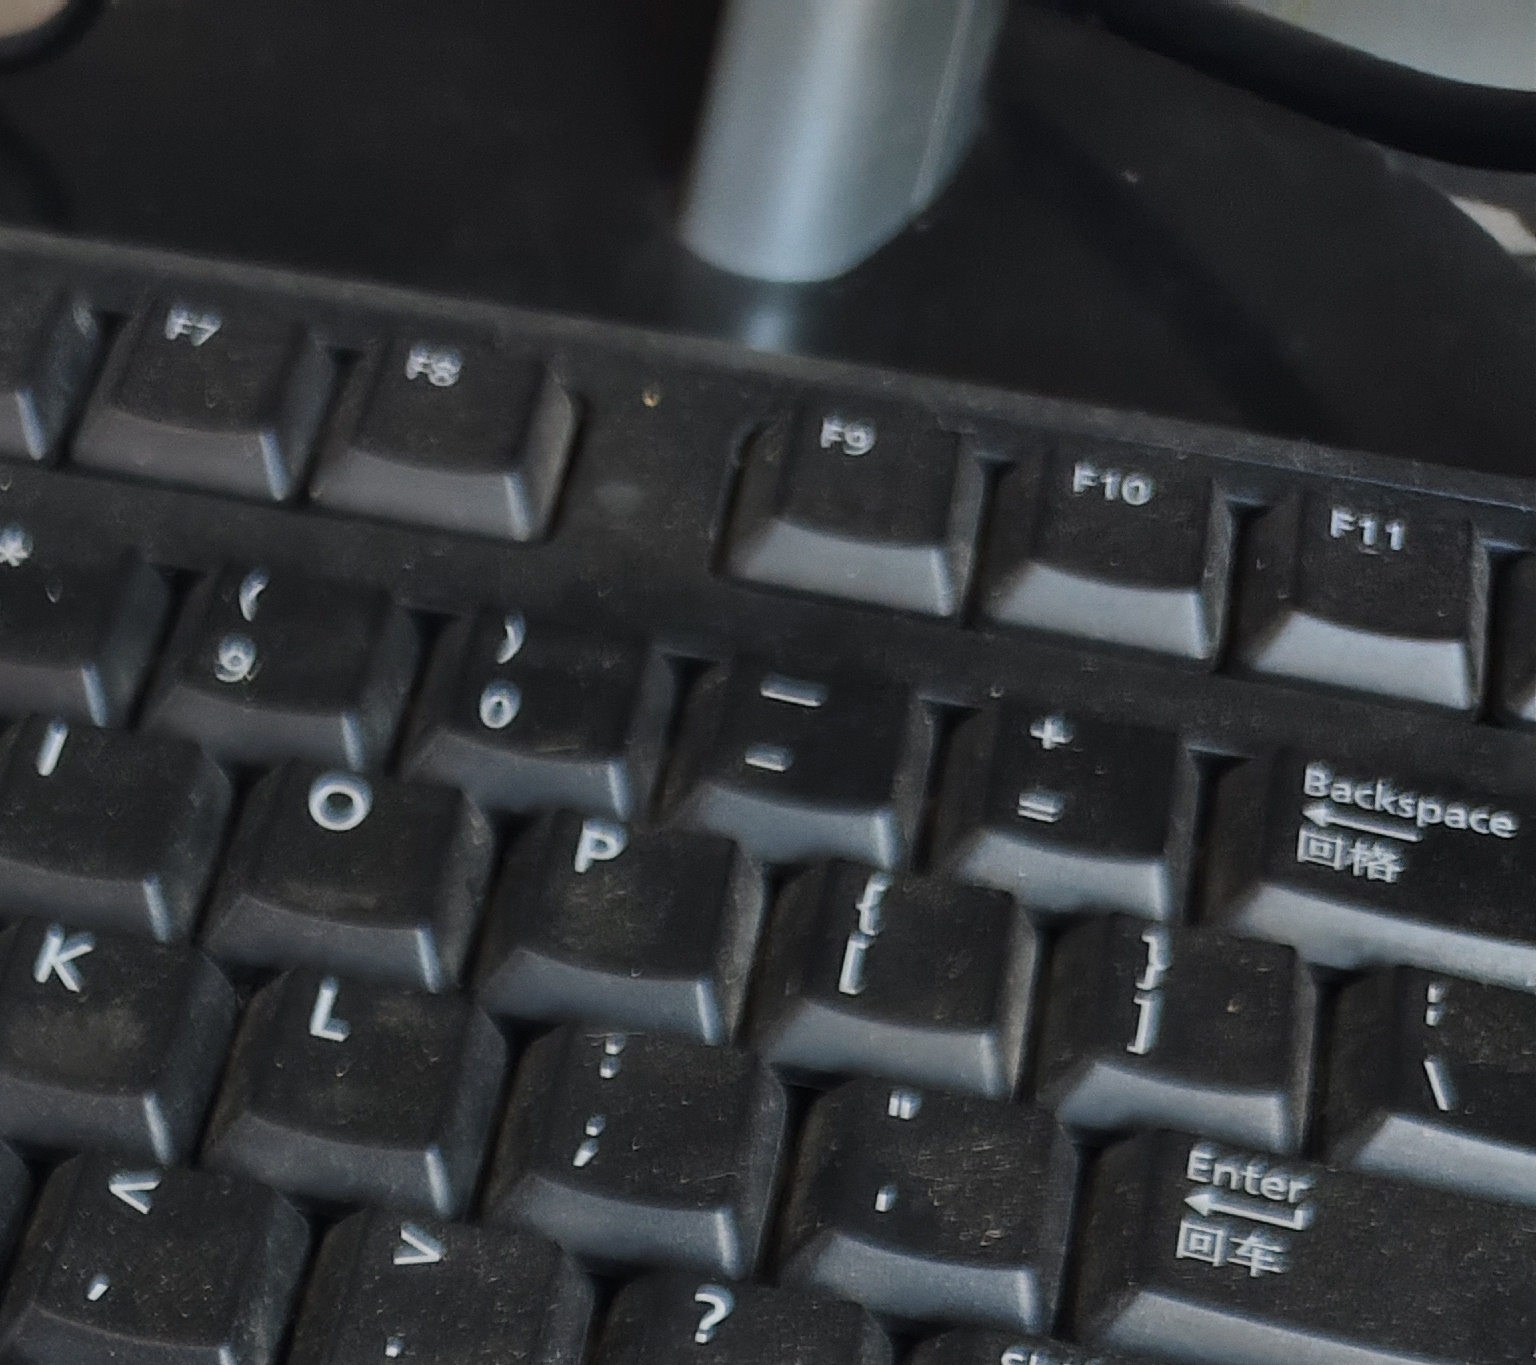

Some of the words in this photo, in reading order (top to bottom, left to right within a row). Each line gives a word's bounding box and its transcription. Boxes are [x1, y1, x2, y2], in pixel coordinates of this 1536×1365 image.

[165, 309, 221, 346] F7
[406, 348, 461, 387] F8
[820, 418, 875, 456] F9
[1072, 462, 1153, 506] F10
[1330, 507, 1405, 552] F11
[216, 641, 255, 683] 9
[479, 688, 520, 729] 0
[37, 725, 68, 777] I
[1029, 717, 1071, 750] +
[308, 777, 370, 831] O
[1017, 793, 1061, 823] =
[1302, 763, 1518, 840] Backspace
[574, 821, 624, 873] P
[1296, 826, 1404, 883] 回格
[34, 931, 93, 993] K
[310, 983, 347, 1042] L
[108, 1173, 160, 1215] <
[1184, 1146, 1313, 1204] Enter
[393, 1226, 444, 1265] >
[1176, 1219, 1288, 1277] 回车
[694, 1287, 731, 1344] ?
